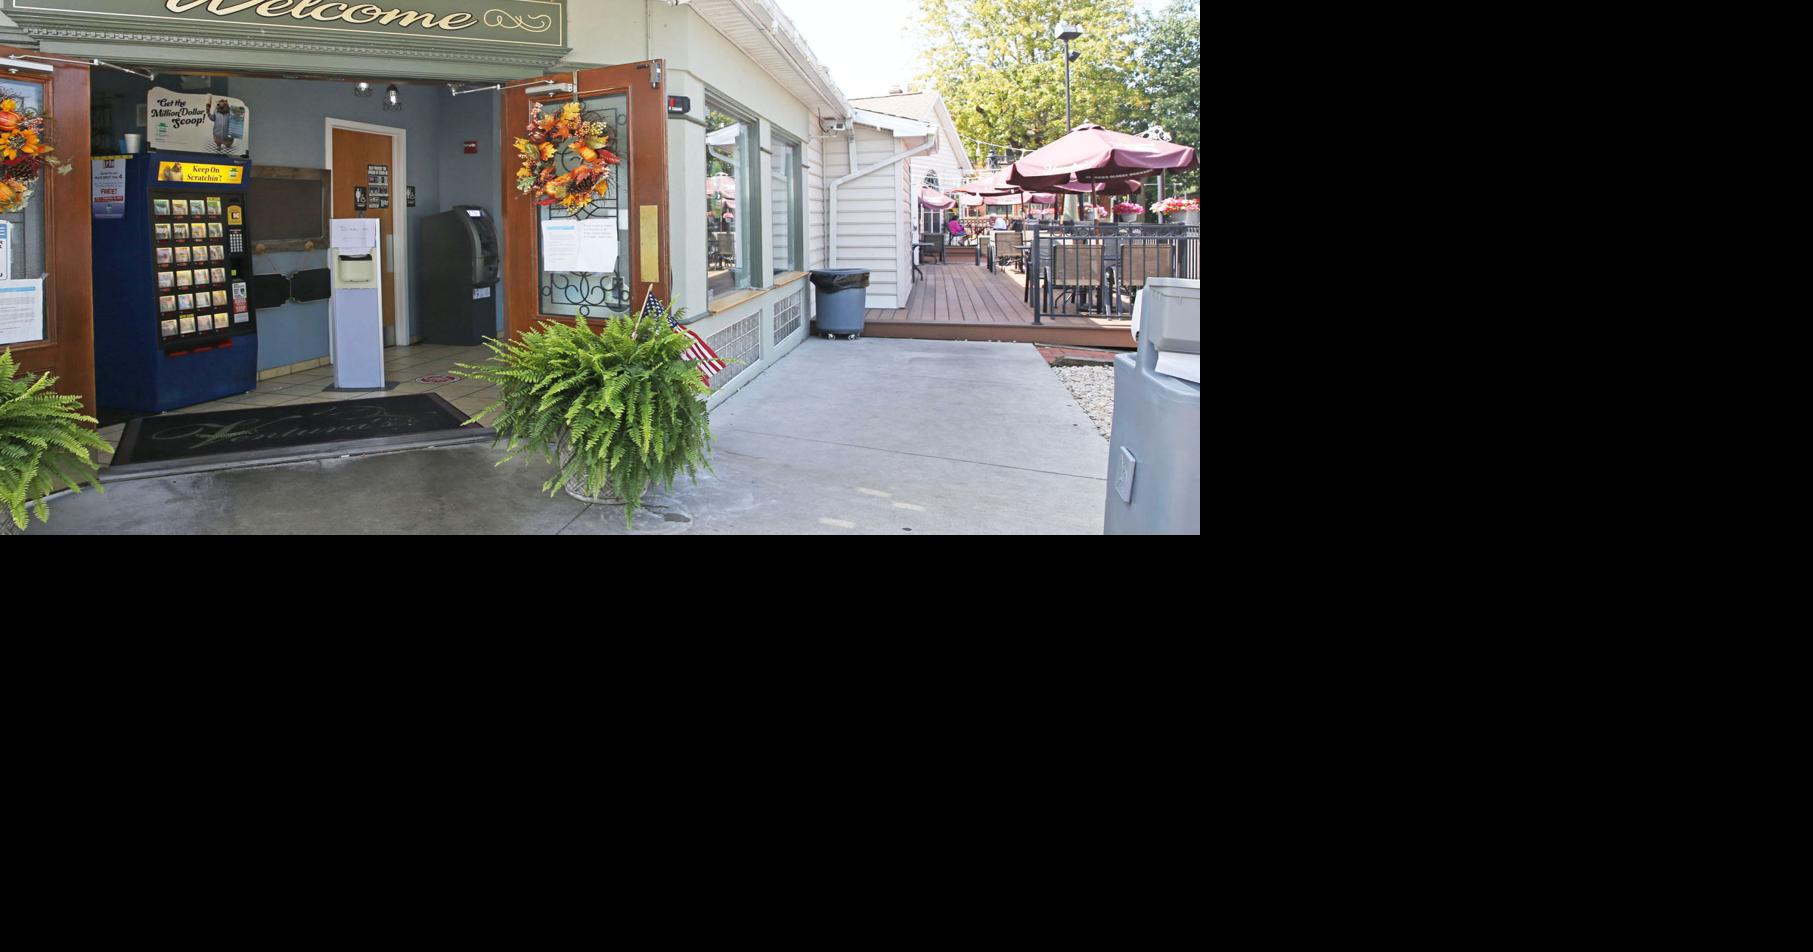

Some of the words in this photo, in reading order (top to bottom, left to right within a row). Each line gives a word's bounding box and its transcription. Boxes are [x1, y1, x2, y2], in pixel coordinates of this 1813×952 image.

[156, 98, 174, 107] Get
[174, 98, 187, 108] the
[151, 108, 181, 118] Million
[179, 107, 205, 116] Dollar
[171, 113, 206, 129] Scoop!
[192, 165, 210, 175] Keep
